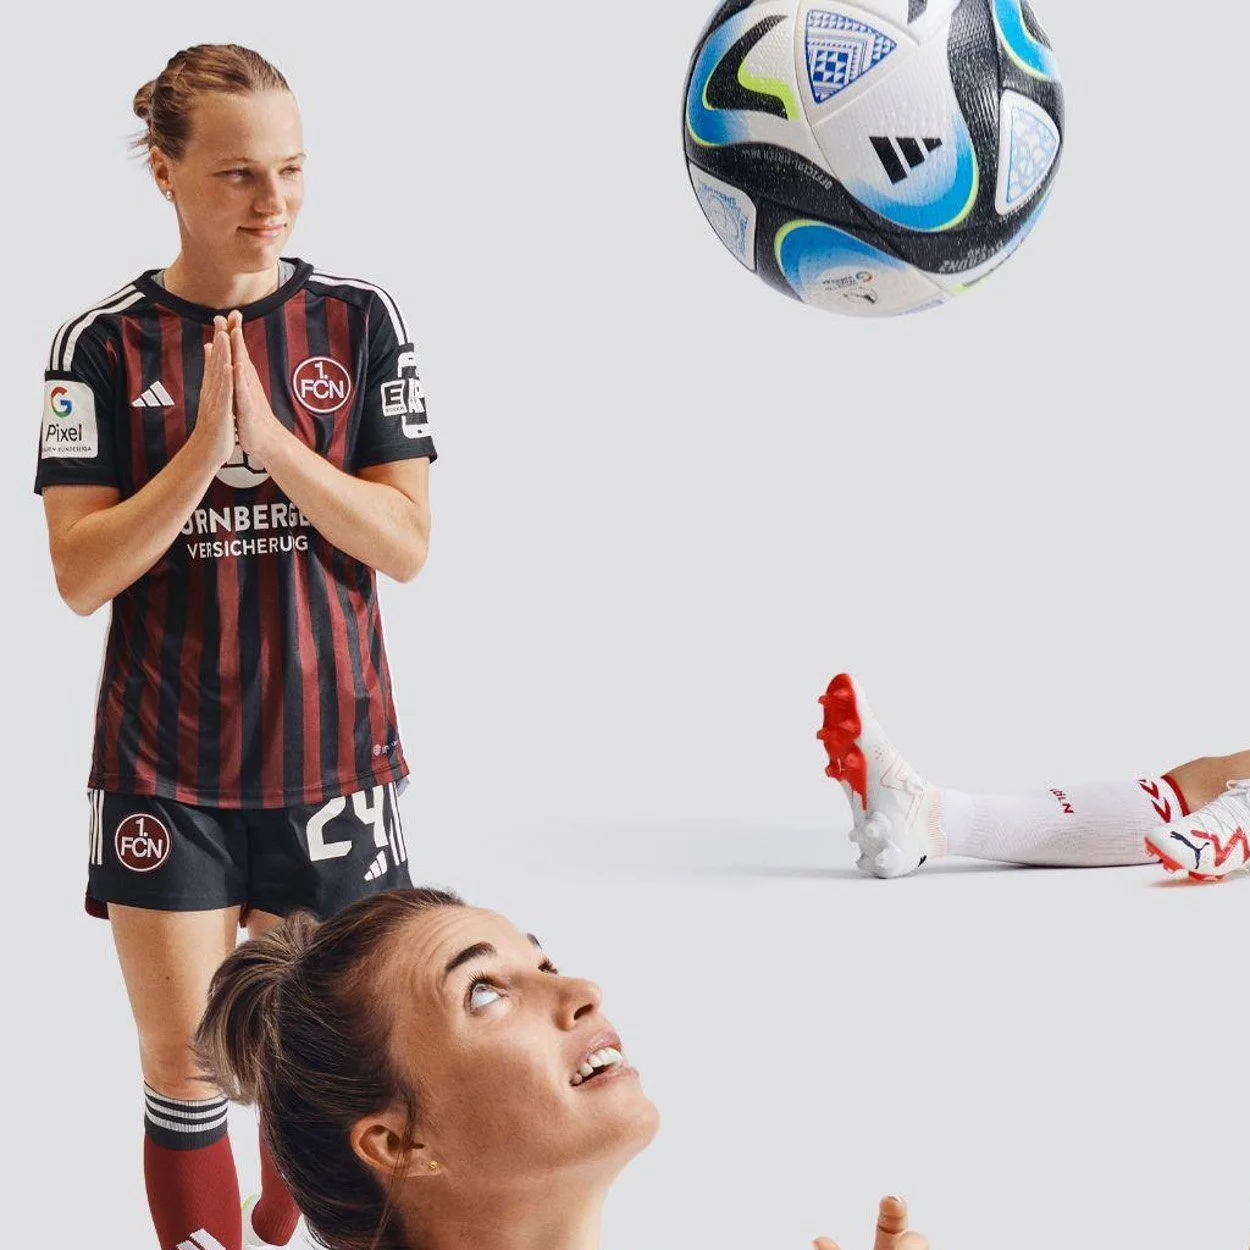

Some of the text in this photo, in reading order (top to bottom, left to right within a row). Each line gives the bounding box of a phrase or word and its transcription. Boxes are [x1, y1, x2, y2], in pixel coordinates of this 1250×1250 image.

[301, 379, 344, 399] FCN
[45, 423, 83, 442] Pixel
[306, 784, 389, 862] 24
[121, 836, 163, 859] FCN
